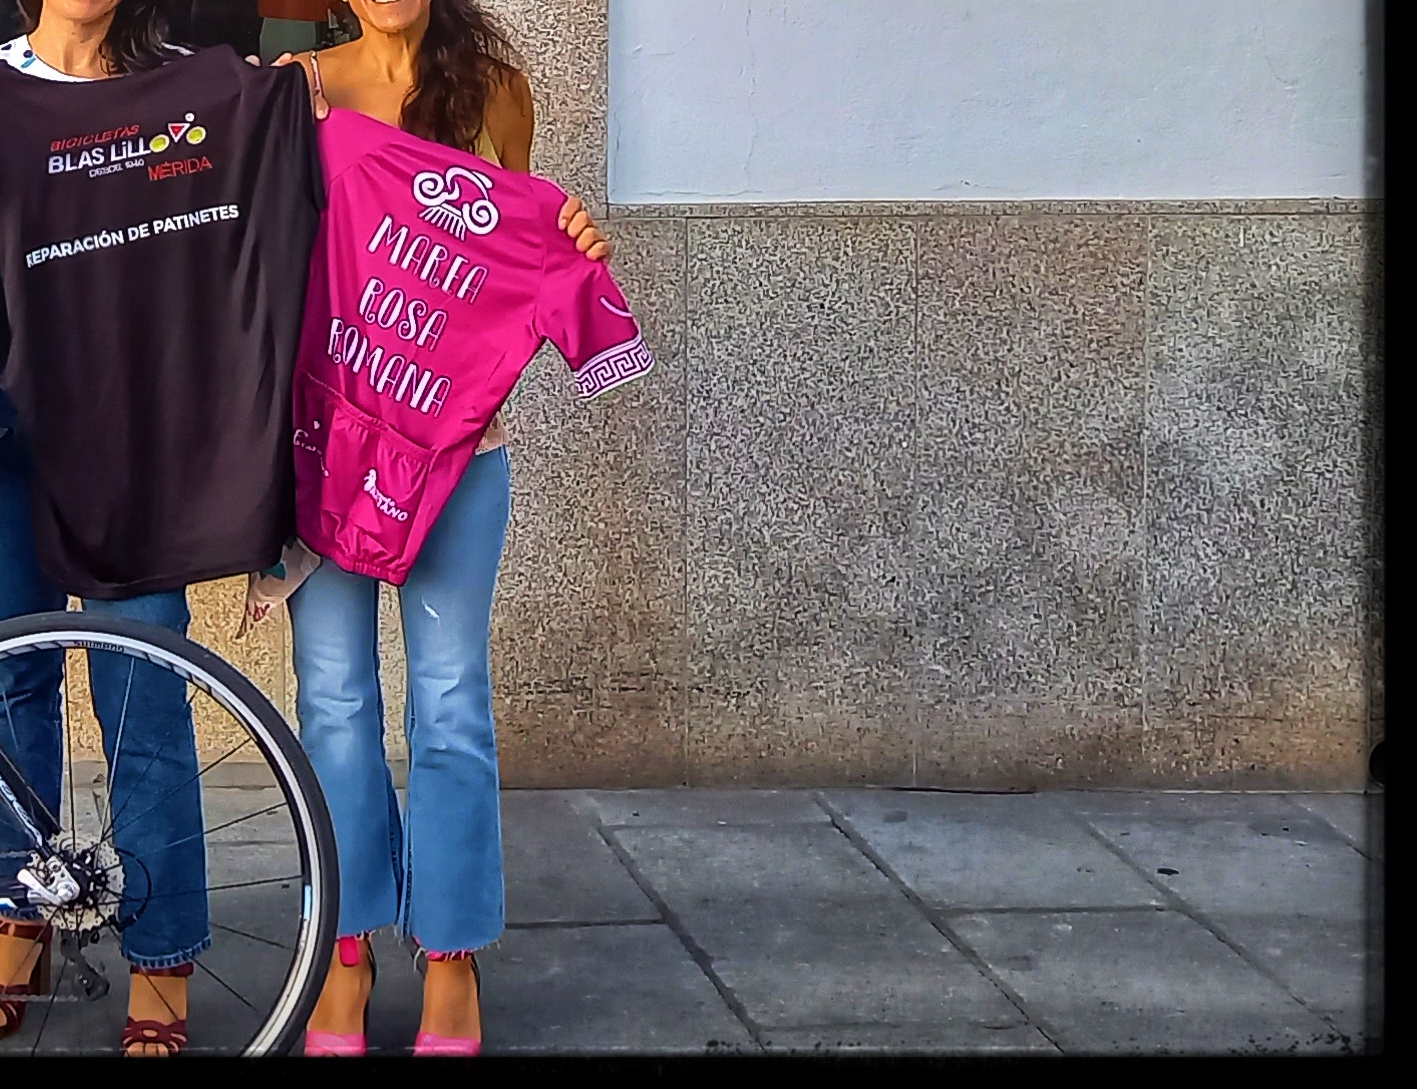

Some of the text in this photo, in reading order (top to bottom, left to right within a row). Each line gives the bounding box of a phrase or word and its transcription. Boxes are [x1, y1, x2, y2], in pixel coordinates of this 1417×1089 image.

[50, 124, 141, 153] BICICLETAS
[48, 146, 105, 175] BLAS
[147, 155, 213, 182] MÉRIDA
[127, 222, 151, 242] DE
[153, 204, 240, 236] PATINETES
[366, 214, 489, 305] MAREA
[358, 276, 449, 351] ROSA
[327, 316, 453, 419] ROMANA
